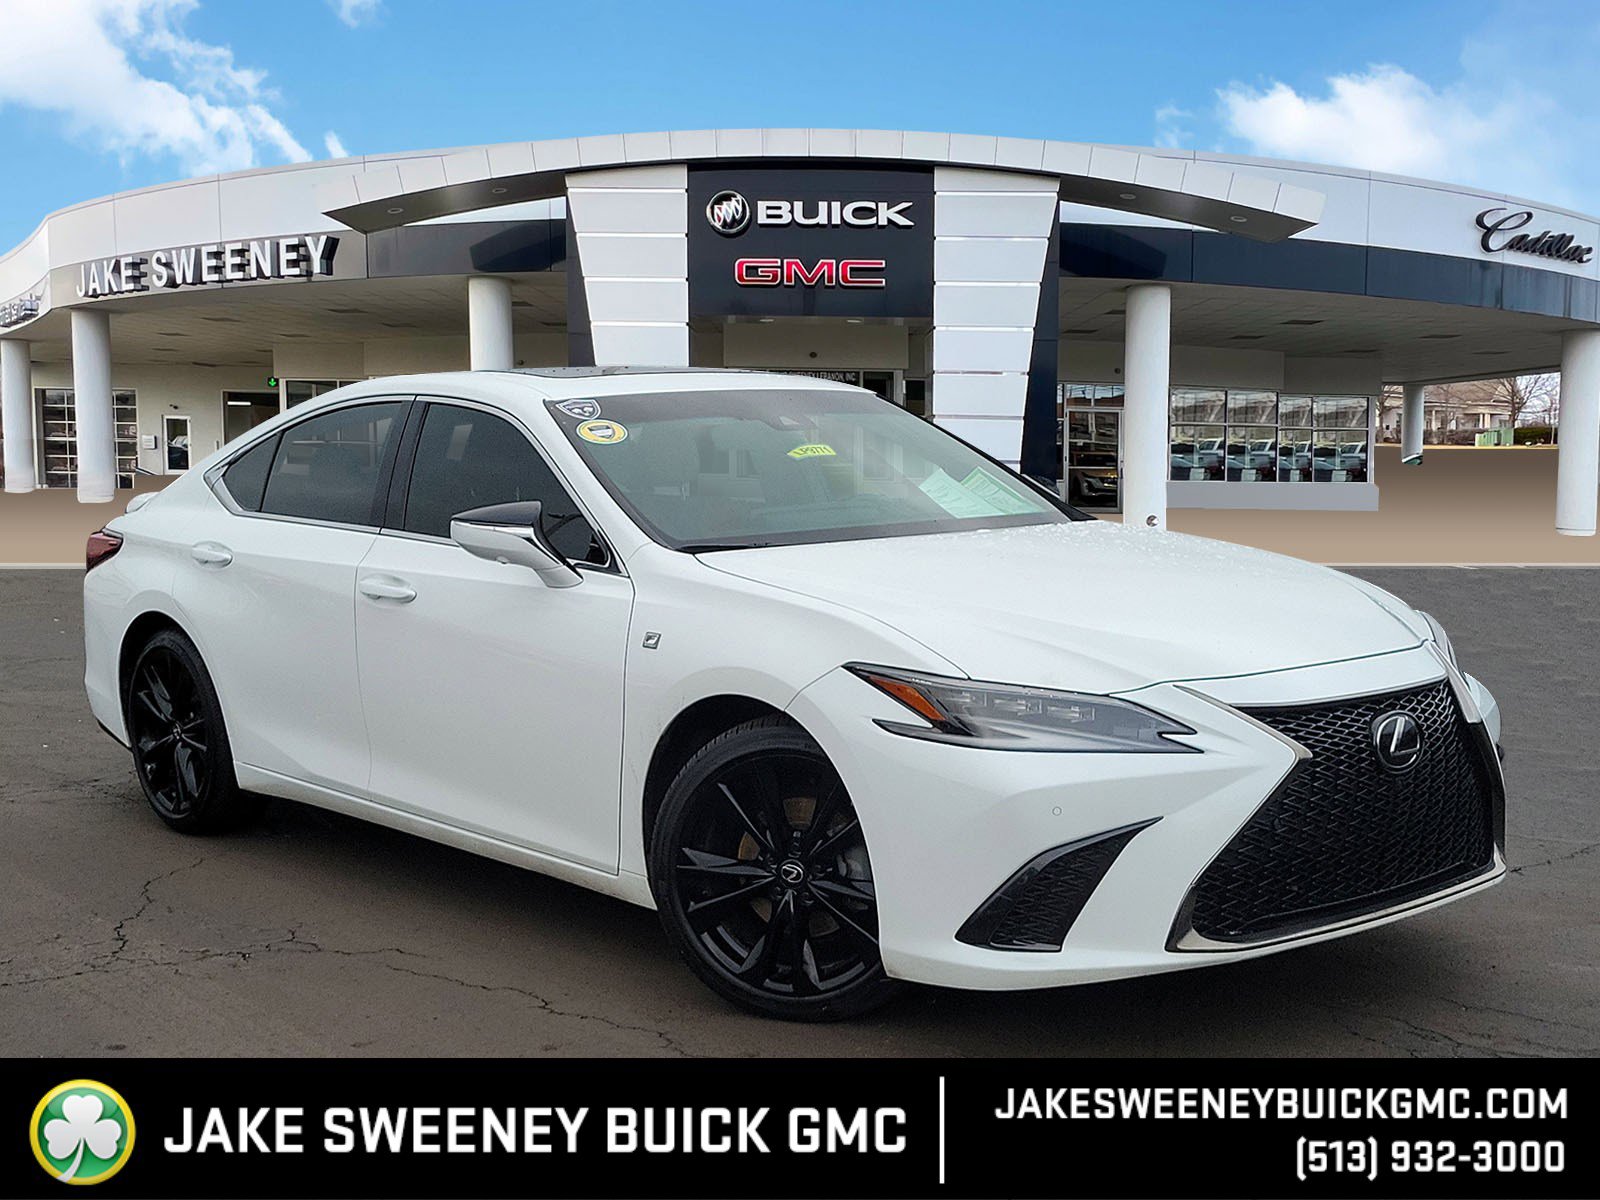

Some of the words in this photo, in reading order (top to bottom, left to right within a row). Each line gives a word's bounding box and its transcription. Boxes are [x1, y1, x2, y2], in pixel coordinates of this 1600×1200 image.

[757, 200, 915, 227] BUICK
[1475, 207, 1593, 264] Cadillac
[76, 256, 138, 297] JAKE
[151, 235, 332, 287] SWEENEY
[734, 258, 886, 286] GMC
